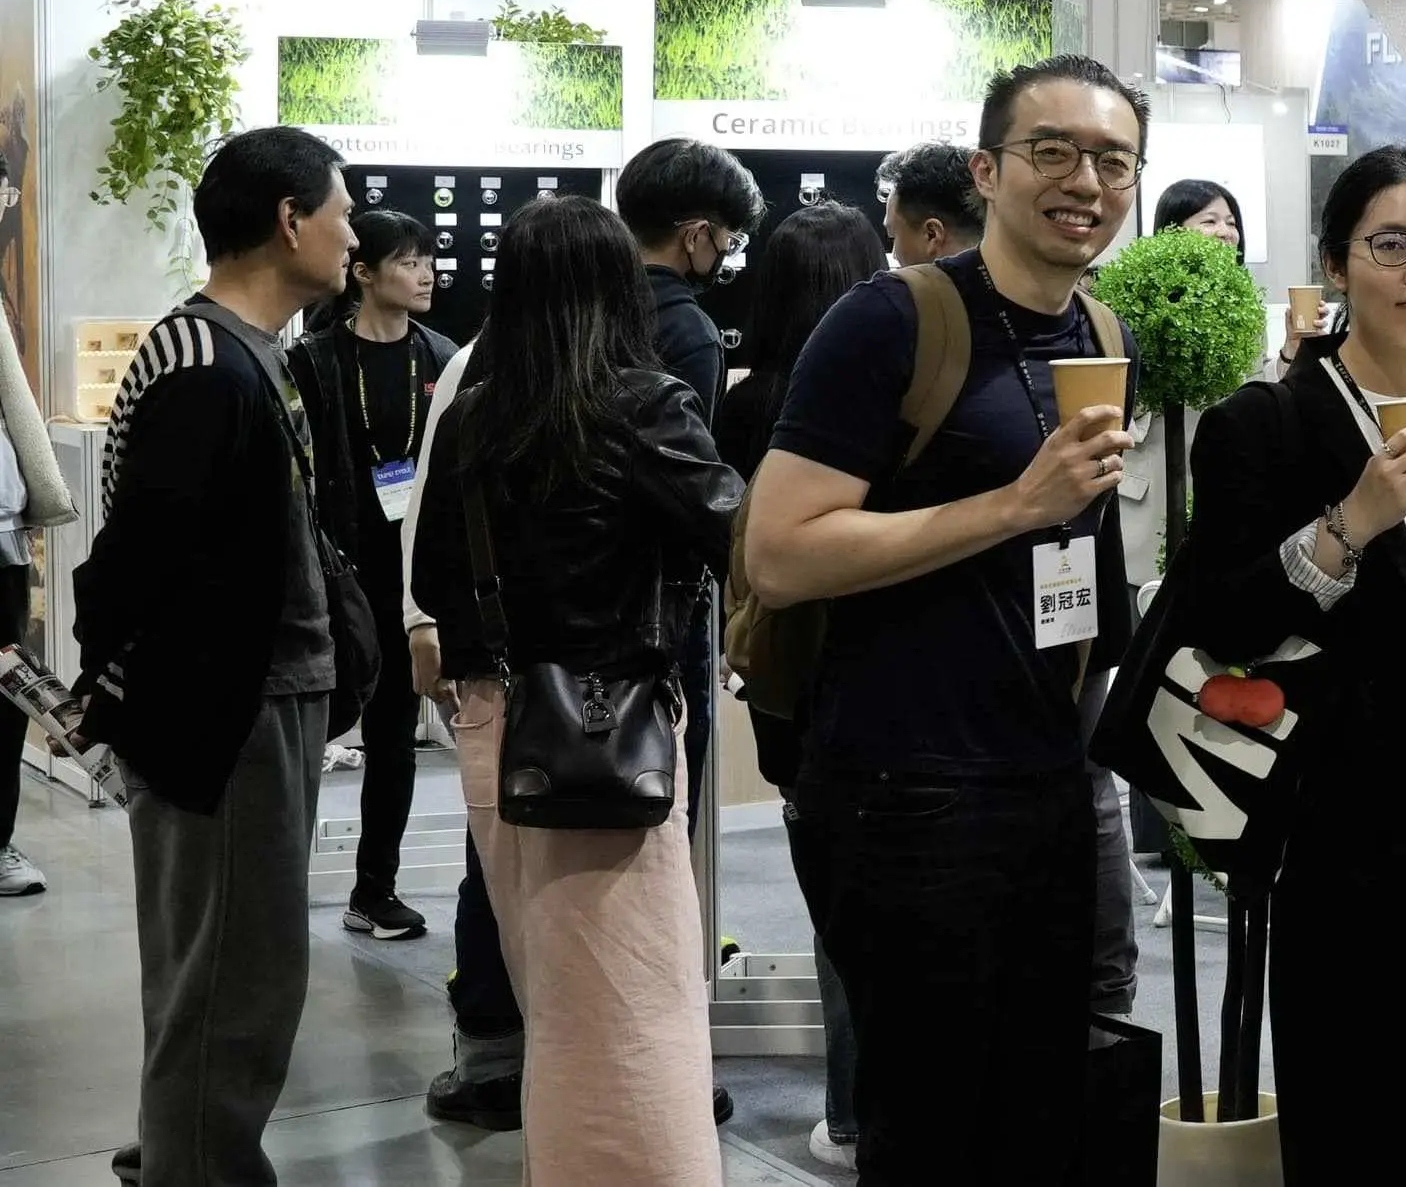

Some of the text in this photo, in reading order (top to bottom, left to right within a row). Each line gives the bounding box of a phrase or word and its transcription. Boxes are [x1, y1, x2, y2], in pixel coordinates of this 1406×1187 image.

[712, 113, 830, 135] Ceramic
[1040, 588, 1091, 615] 劉冠宏
